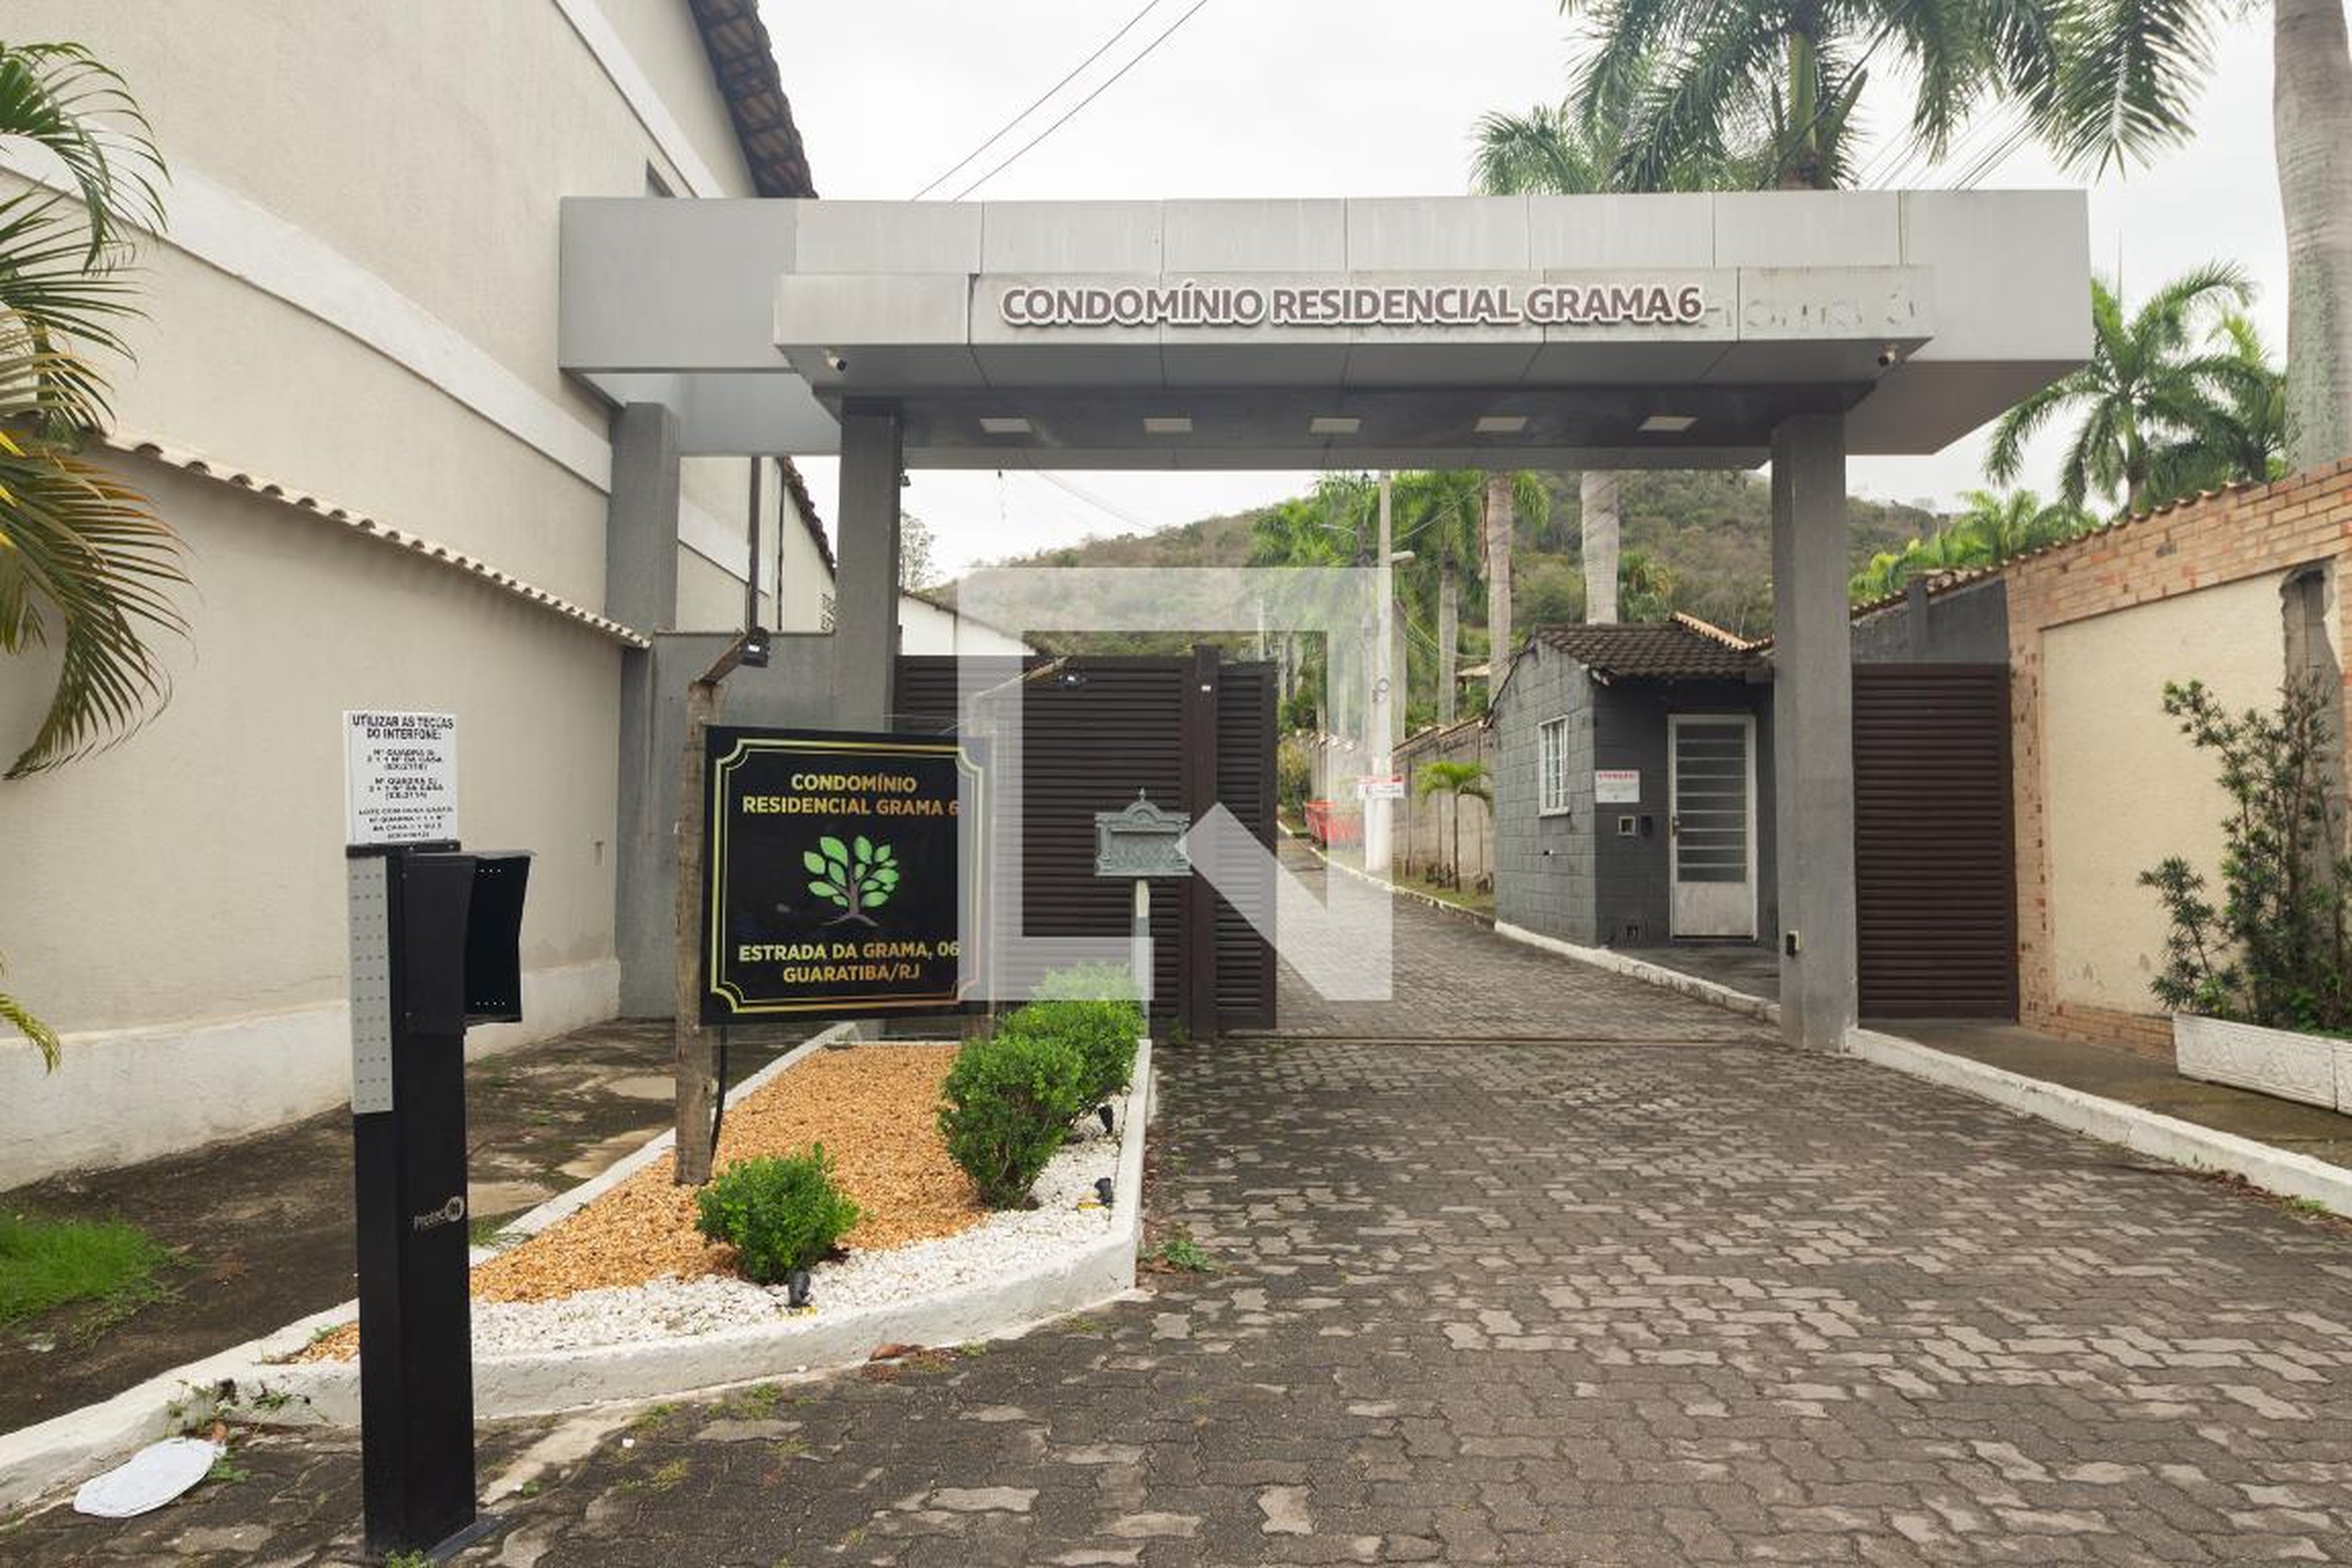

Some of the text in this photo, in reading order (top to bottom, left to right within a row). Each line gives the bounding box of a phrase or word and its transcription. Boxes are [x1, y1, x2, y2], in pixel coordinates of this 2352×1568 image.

[1002, 282, 1264, 325] CONDOMÍNIO
[1270, 287, 1522, 325] RESIDENCIAL
[1526, 286, 1675, 324] GRAMA
[1677, 285, 1704, 324] 6
[353, 714, 454, 729] UTILIZAR AS TECLAS
[368, 728, 442, 740] DO INTERFONE:
[791, 773, 917, 793] CONDOMÍNIO
[742, 796, 962, 816] RESIDENCIAL GRAMA 6
[739, 940, 961, 962] ESTRADA DA GRAMA, 06
[783, 963, 921, 984] GUARATIBA/RJ
